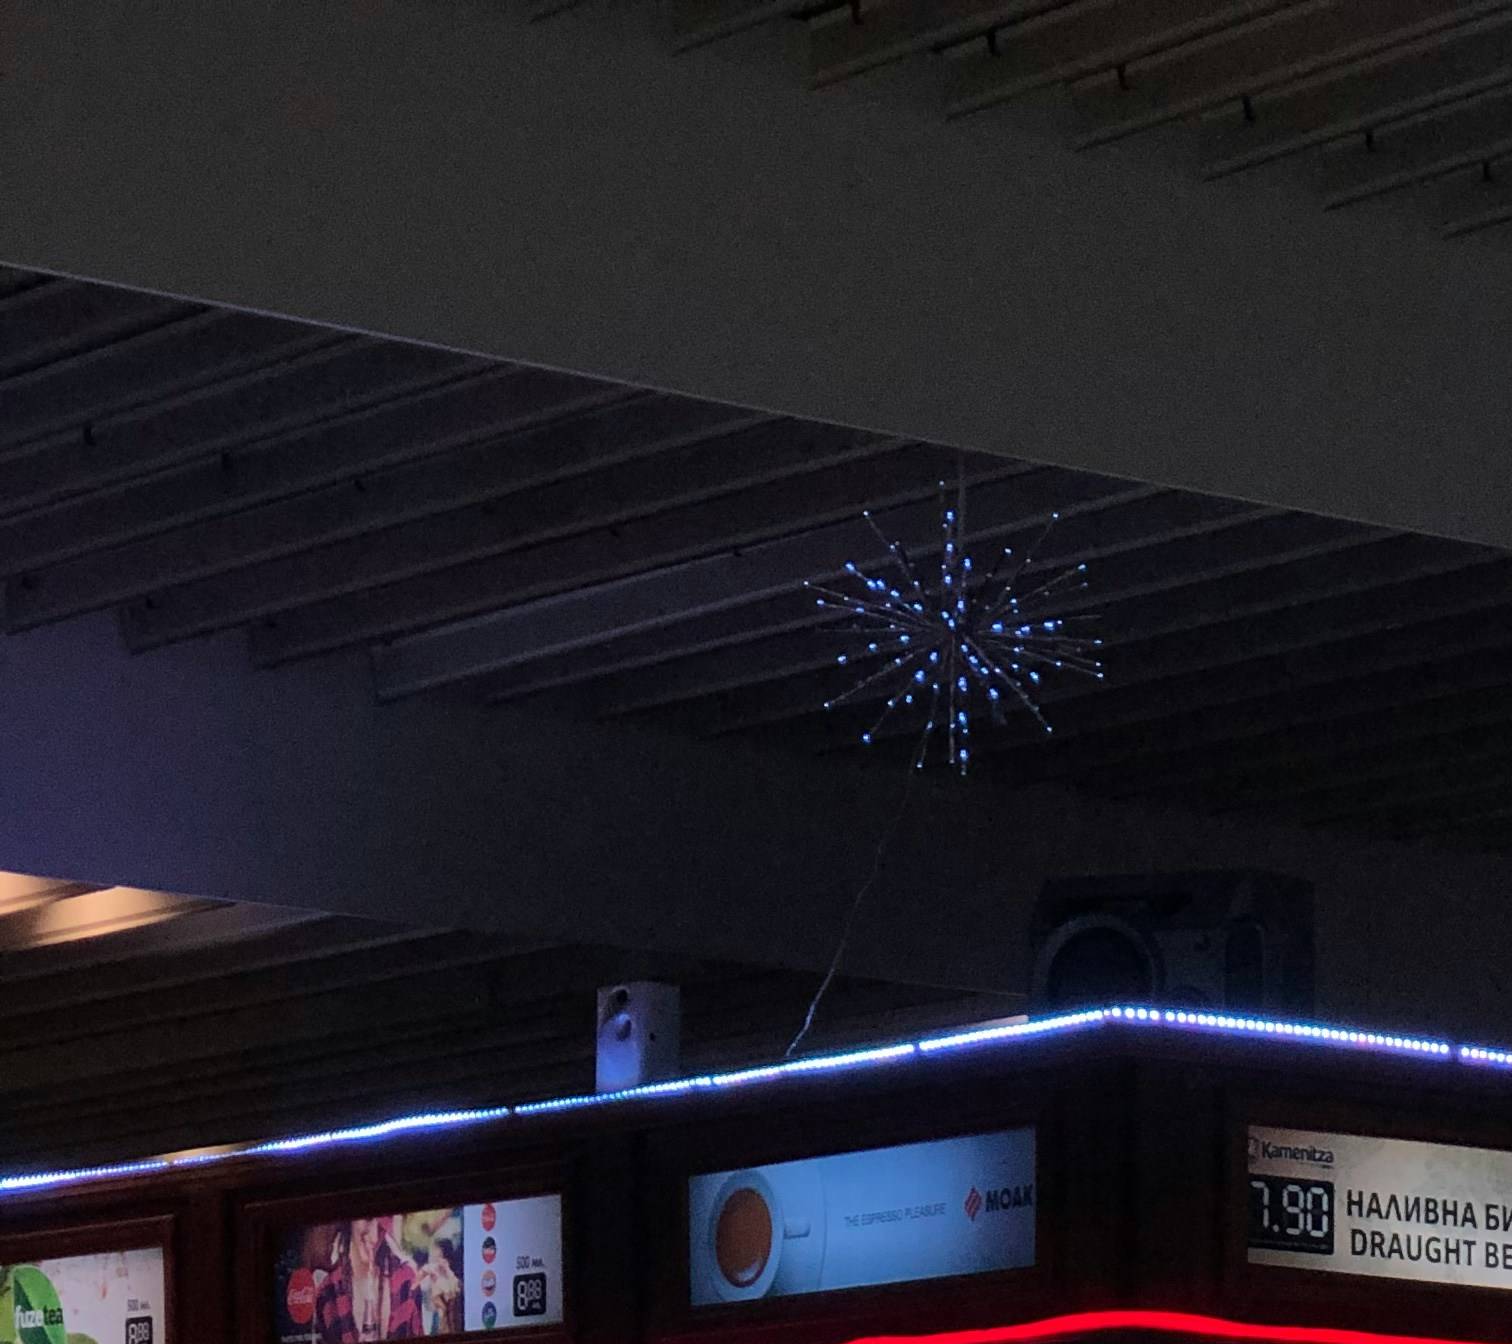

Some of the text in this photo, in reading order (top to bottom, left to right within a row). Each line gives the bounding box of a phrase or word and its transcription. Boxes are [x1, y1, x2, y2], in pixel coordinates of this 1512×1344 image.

[1262, 1140, 1334, 1163] Kamenitza
[985, 1183, 1034, 1213] MOAK
[1250, 1180, 1329, 1238] 7.90
[1346, 1190, 1477, 1231] НАЛИВНА
[1350, 1228, 1476, 1267] DRAUGHT
